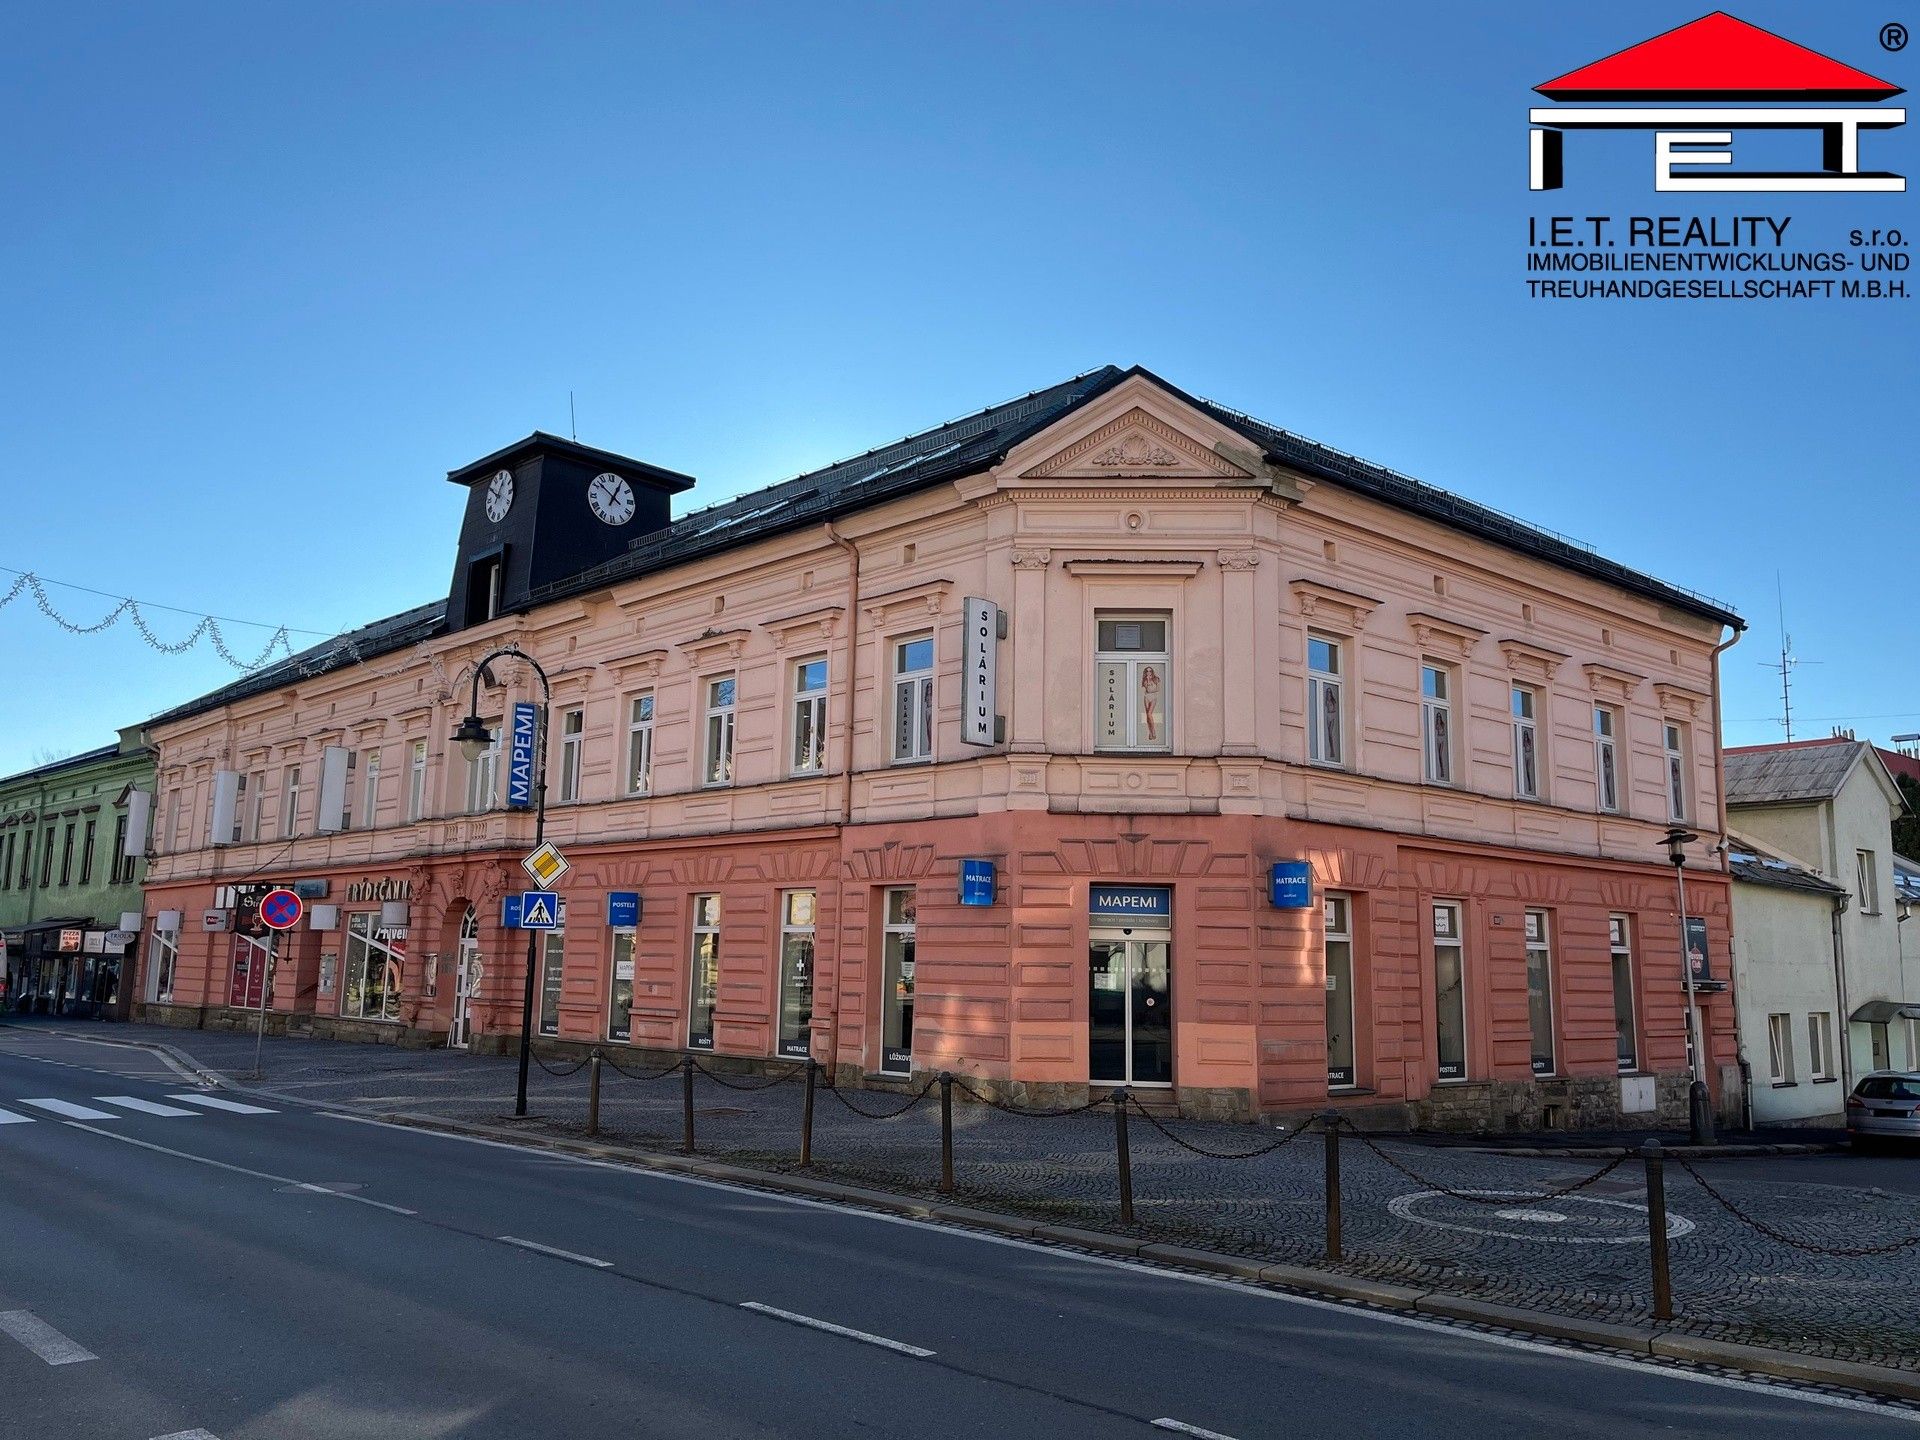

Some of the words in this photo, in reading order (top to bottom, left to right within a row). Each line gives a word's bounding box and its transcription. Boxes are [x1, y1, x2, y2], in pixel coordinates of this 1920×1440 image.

[977, 609, 989, 735] SOLÁRIUM
[1107, 668, 1116, 737] SOLÁRIUM
[510, 706, 534, 802] MAPEMI
[965, 873, 991, 884] MATRACE
[1275, 876, 1306, 885] MATRACE
[1099, 895, 1157, 908] MAPEMI
[786, 1045, 807, 1053] MATRACE
